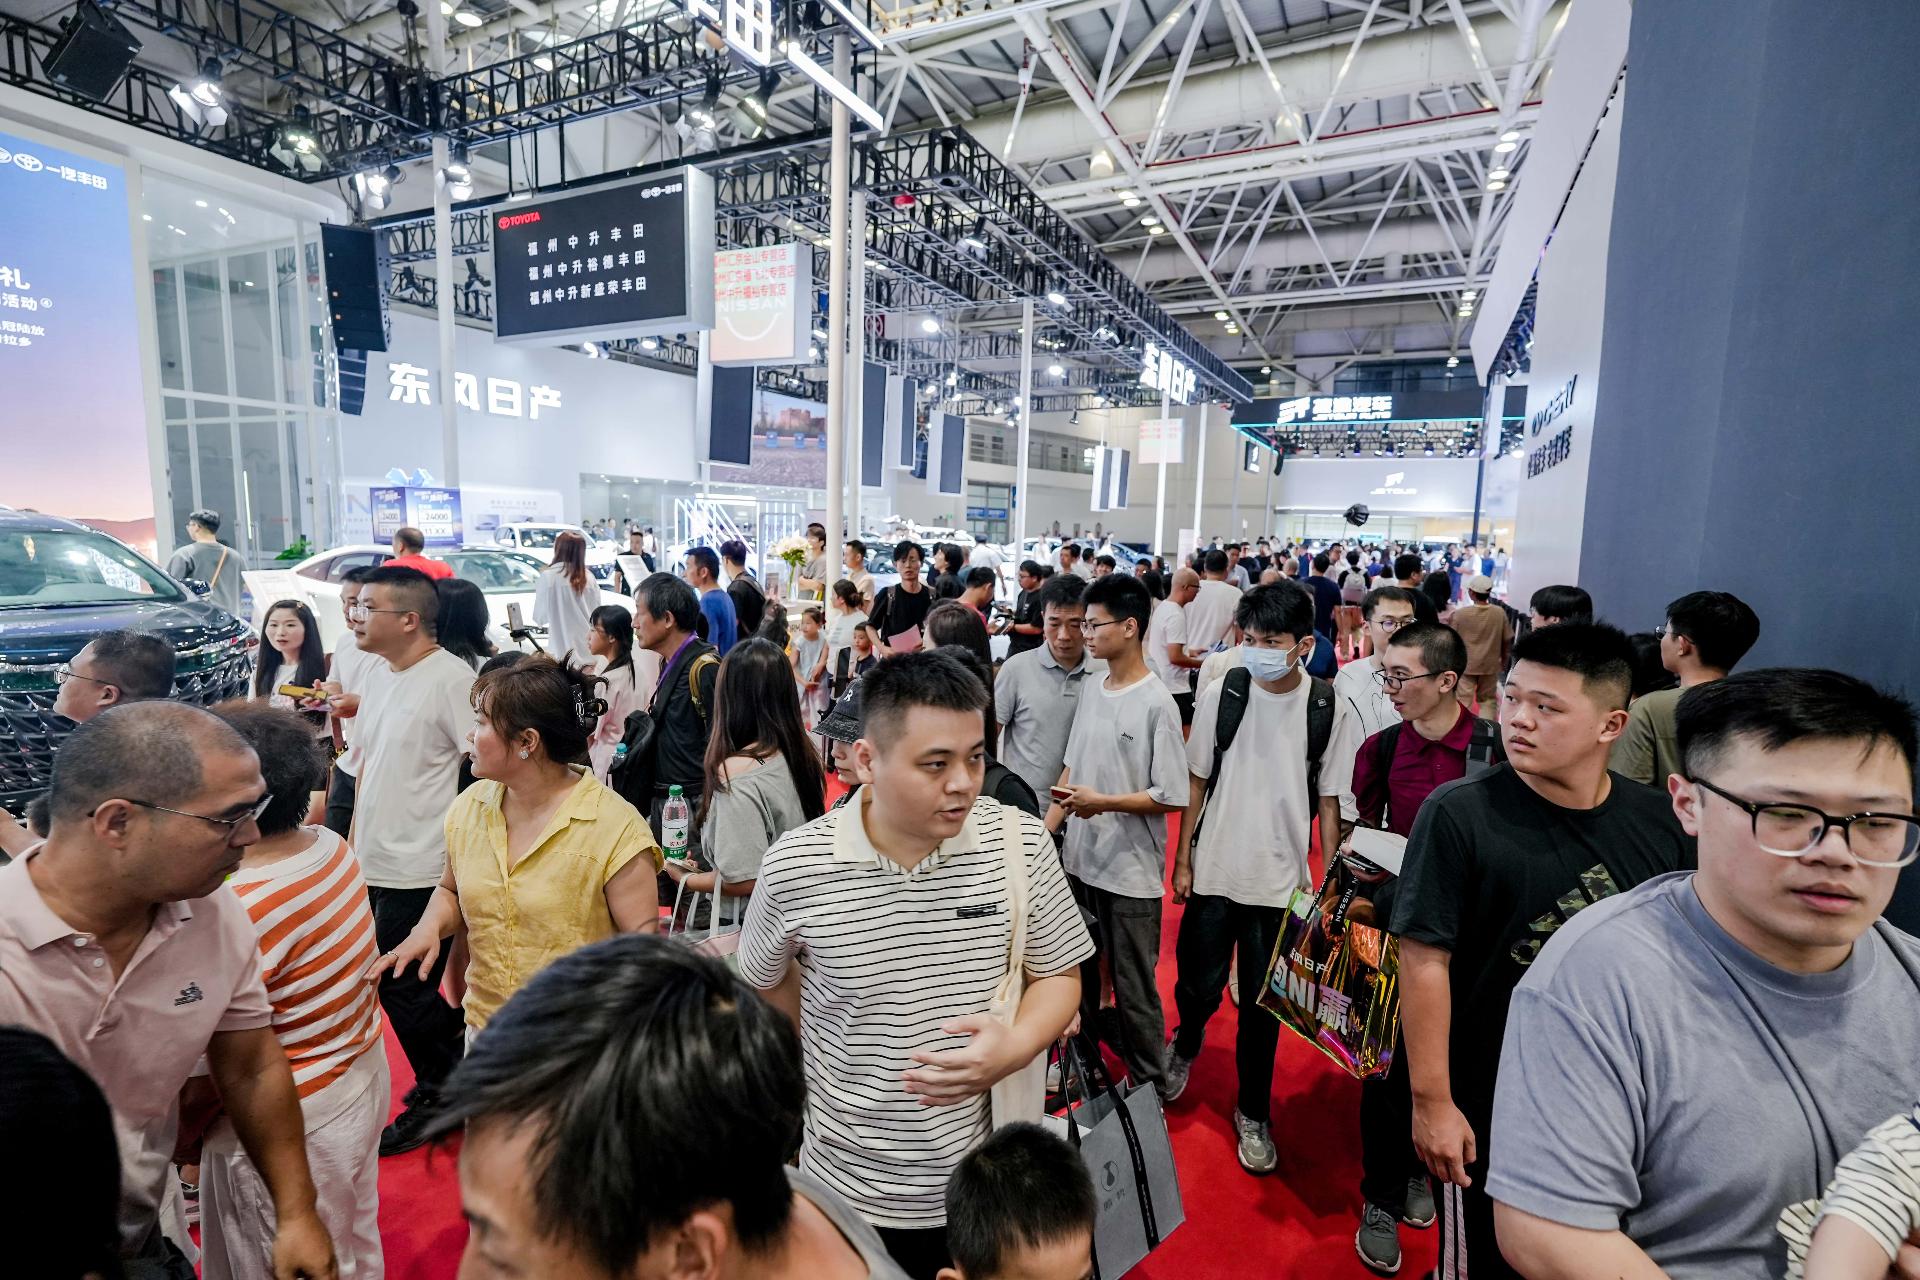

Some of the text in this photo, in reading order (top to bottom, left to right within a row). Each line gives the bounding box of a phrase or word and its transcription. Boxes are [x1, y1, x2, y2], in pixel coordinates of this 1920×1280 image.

[510, 211, 541, 226] TOYOTA
[527, 223, 645, 257] 福州中升丰田
[528, 249, 646, 281] 福州中升裕德丰田
[529, 276, 647, 306] 福州中升新盛荣丰田
[719, 296, 786, 313] NISSAN
[387, 361, 563, 420] 东风日产
[1335, 888, 1353, 923] NISSAN
